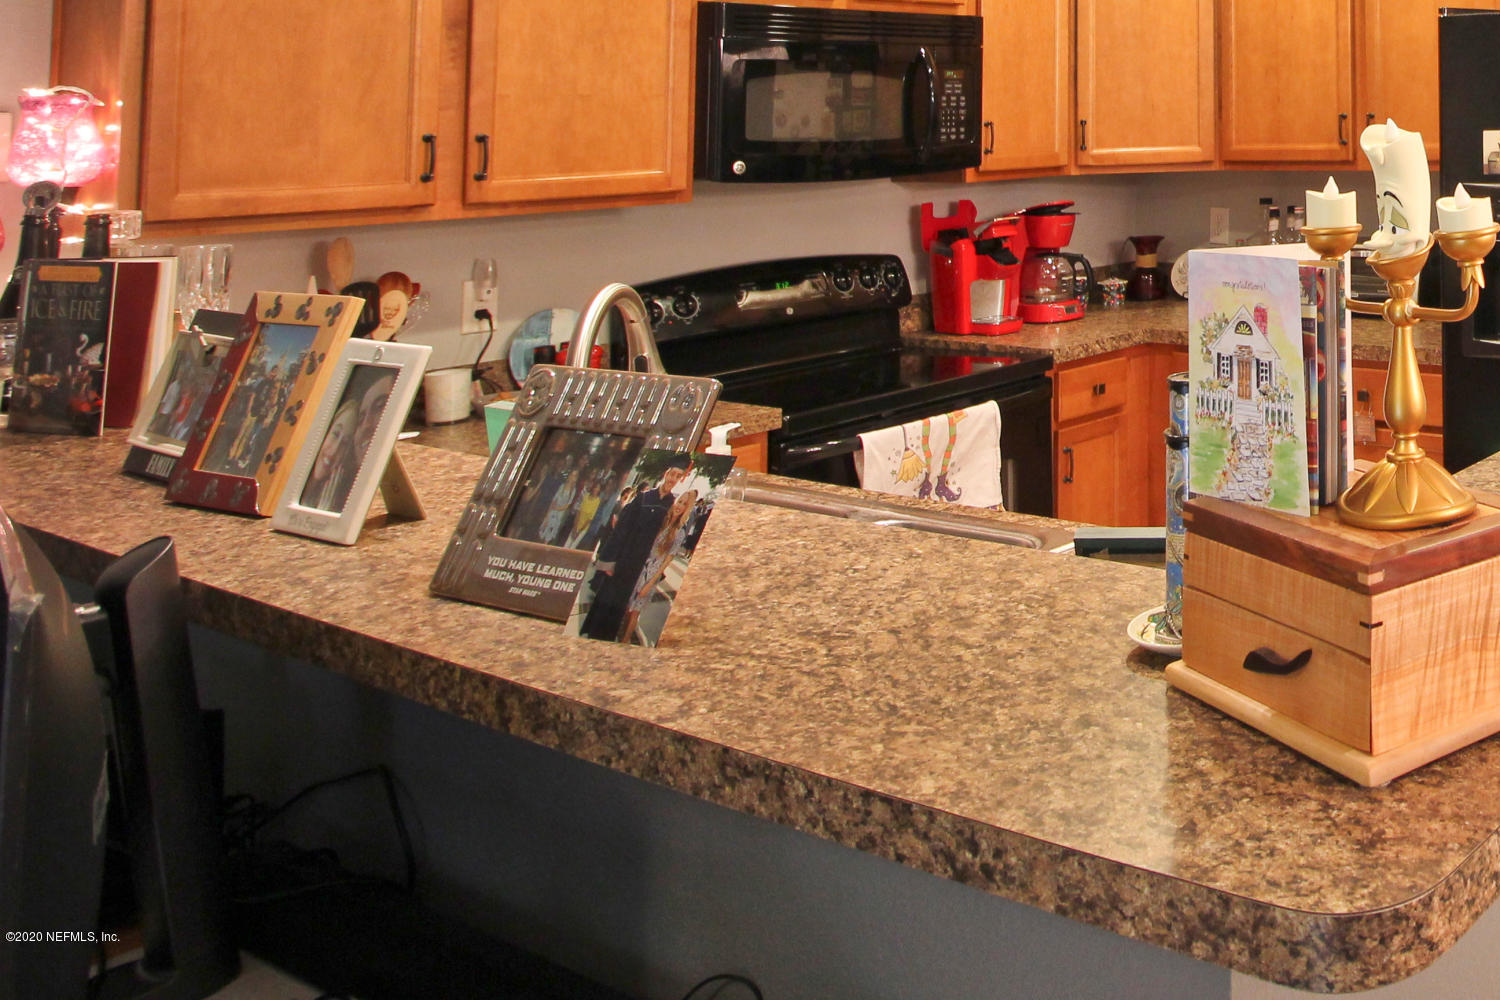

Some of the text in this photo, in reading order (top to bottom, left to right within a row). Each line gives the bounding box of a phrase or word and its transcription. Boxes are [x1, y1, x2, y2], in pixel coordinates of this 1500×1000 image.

[31, 298, 56, 319] ICE
[69, 299, 103, 320] FIRE
[488, 555, 584, 580] YOU HAVE LEARNED
[483, 569, 576, 592] MUCH, YOUNG ONE
